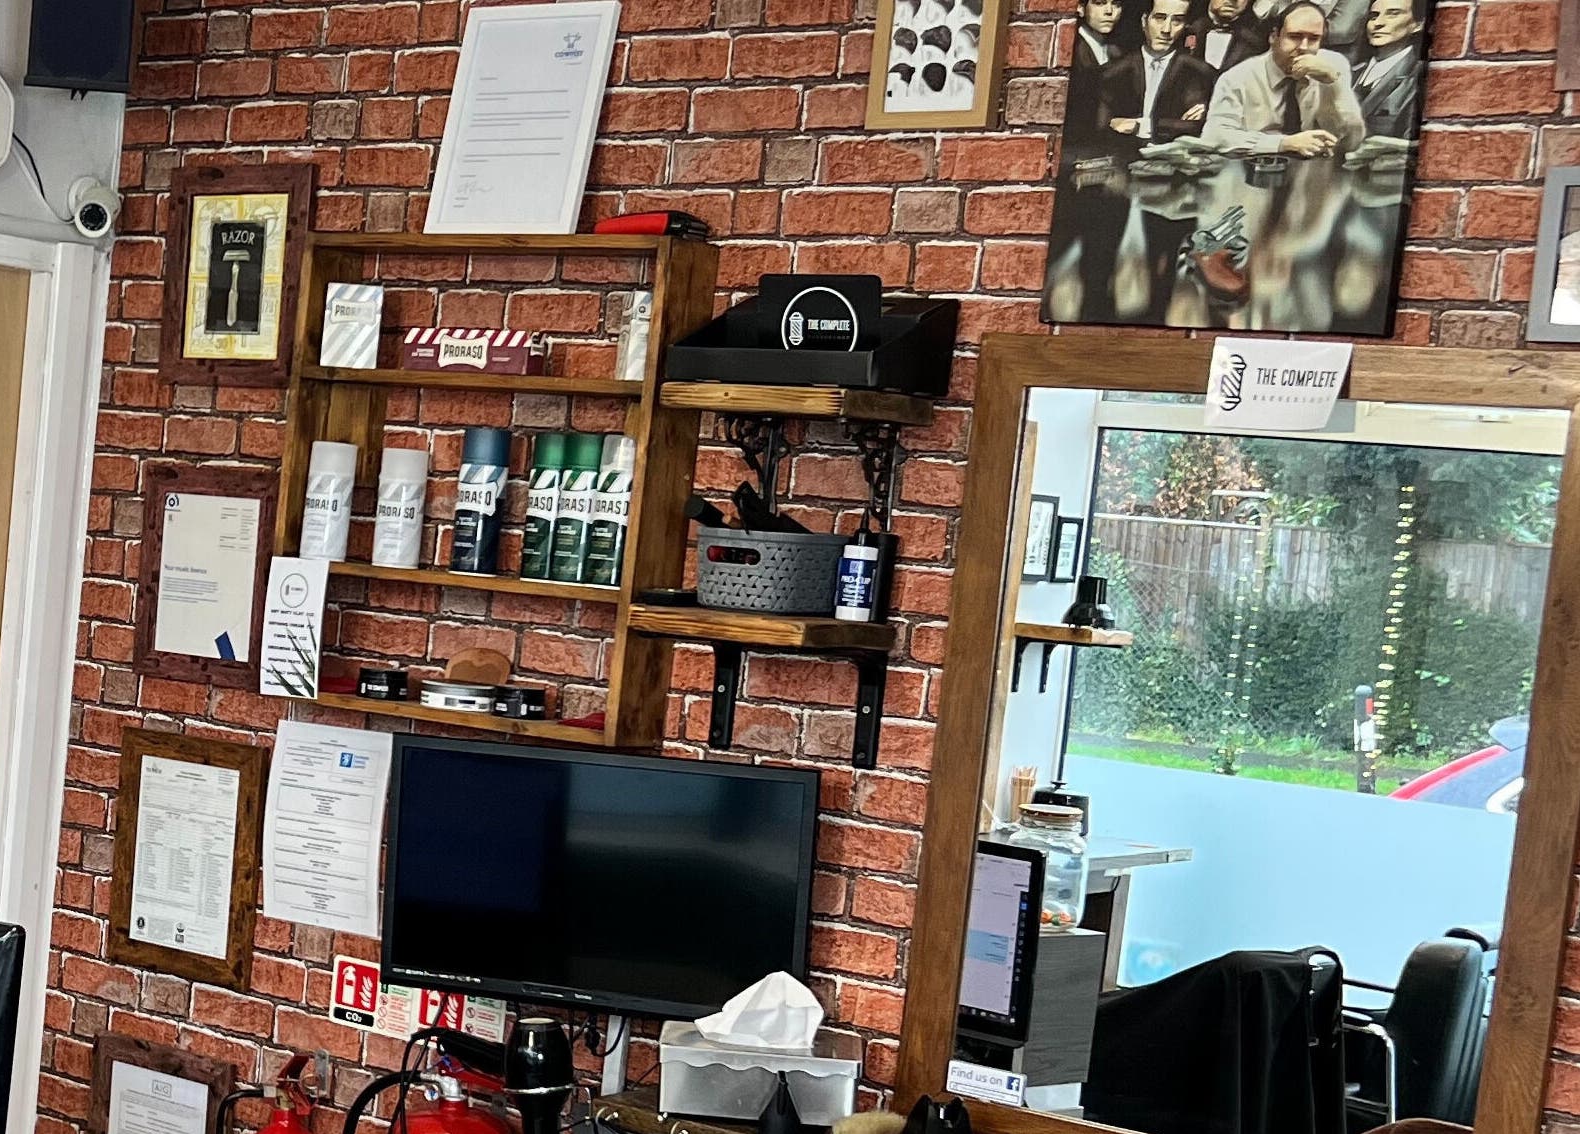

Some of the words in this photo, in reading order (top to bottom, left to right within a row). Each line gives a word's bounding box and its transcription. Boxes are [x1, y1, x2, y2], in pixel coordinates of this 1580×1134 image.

[221, 230, 255, 246] RAZOR
[443, 344, 483, 360] PRORASO
[1256, 367, 1277, 386] THE
[1281, 369, 1338, 388] COMPLETE
[951, 1066, 974, 1080] Find
[976, 1073, 988, 1082] us
[989, 1077, 1003, 1086] on
